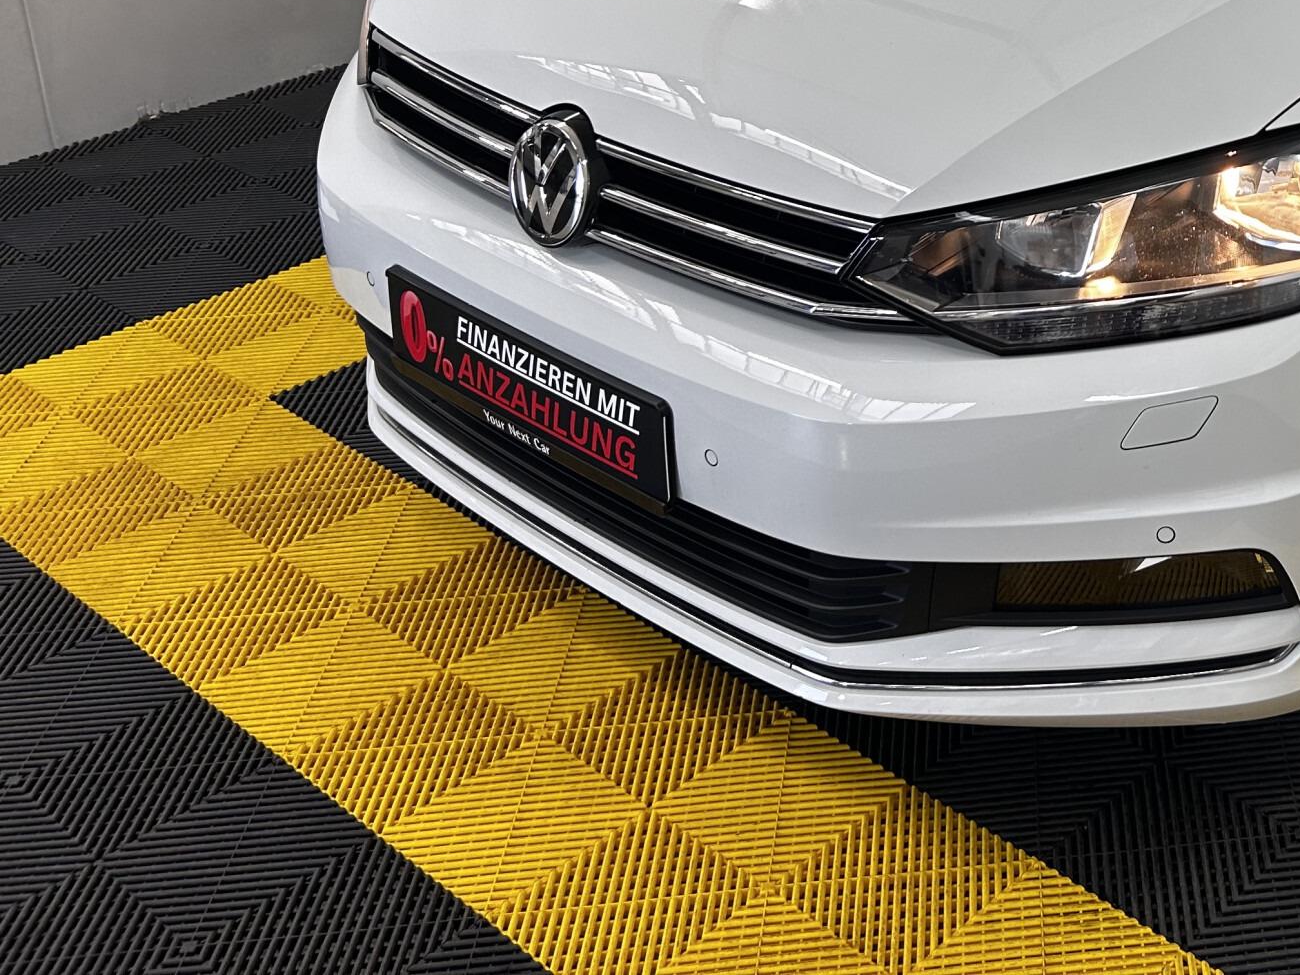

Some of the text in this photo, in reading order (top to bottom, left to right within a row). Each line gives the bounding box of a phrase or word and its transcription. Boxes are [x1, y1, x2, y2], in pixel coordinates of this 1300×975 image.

[511, 121, 588, 244] VW
[400, 290, 637, 471] 0% ANZAHLUNG
[457, 315, 640, 428] FINANZIEREN MIT
[483, 408, 551, 456] Your Next Car
